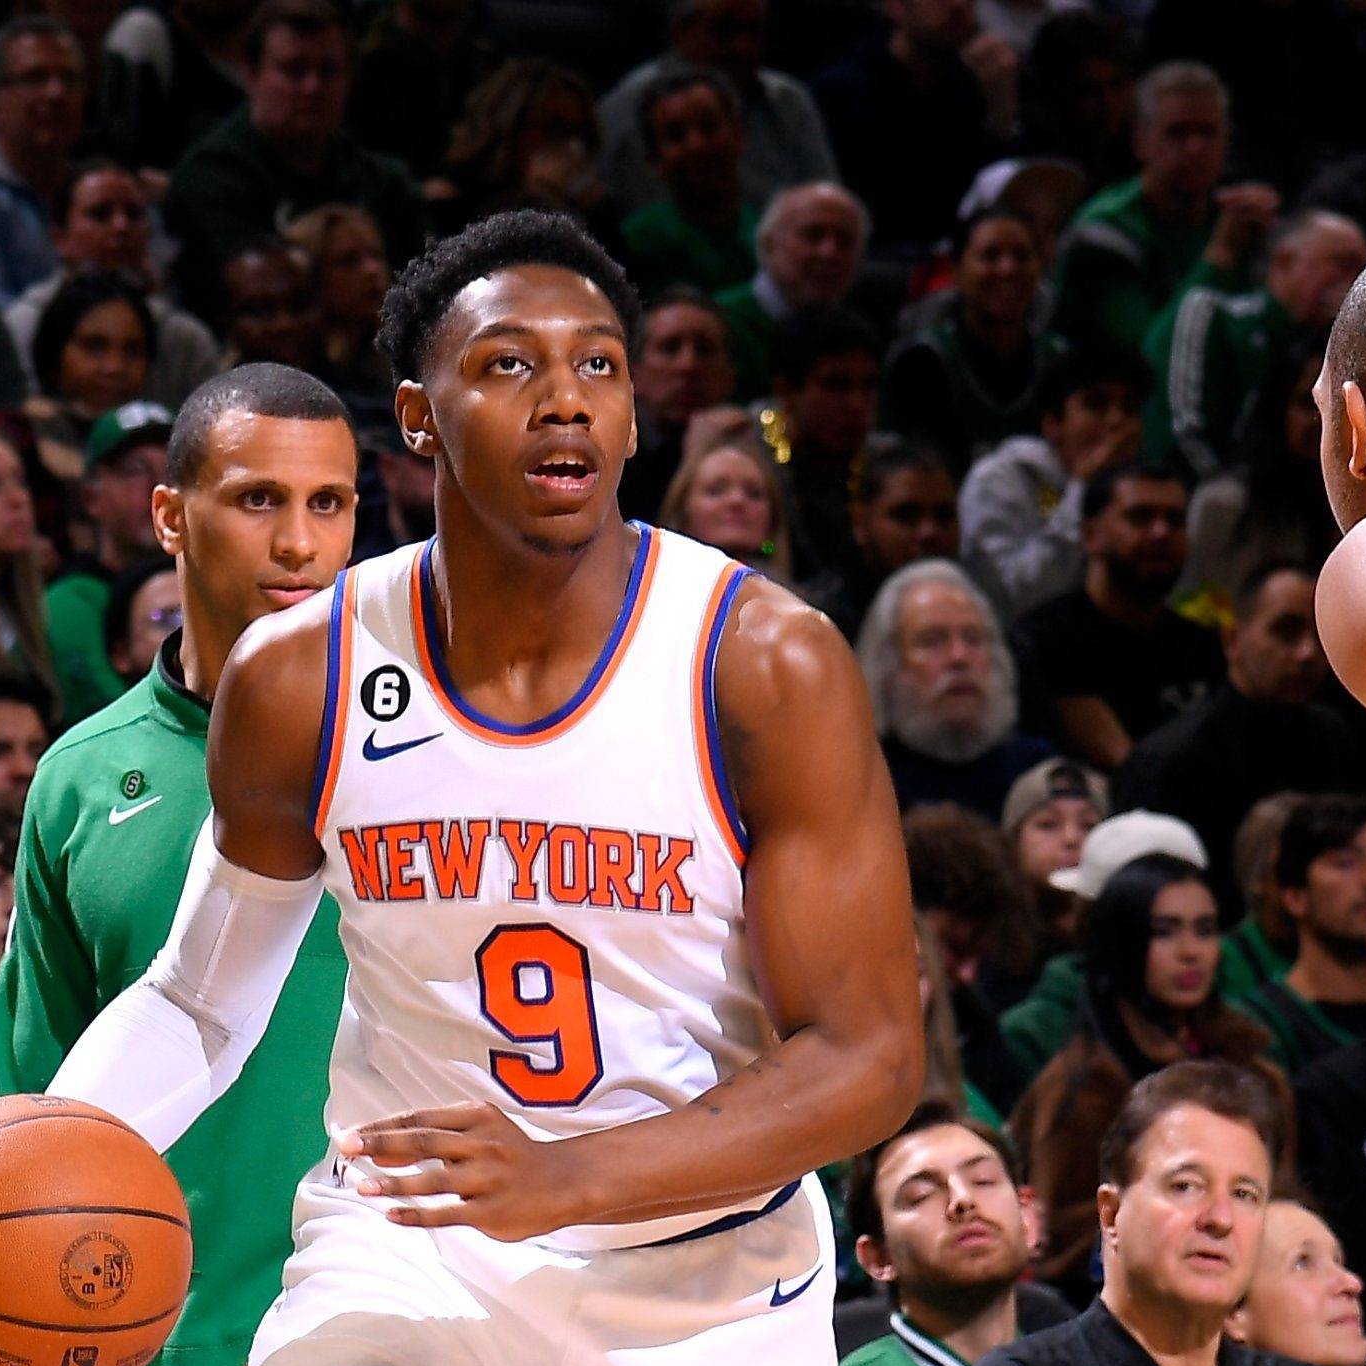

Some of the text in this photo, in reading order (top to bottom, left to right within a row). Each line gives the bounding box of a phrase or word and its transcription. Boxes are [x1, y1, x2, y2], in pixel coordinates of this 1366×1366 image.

[373, 672, 401, 716] 6
[124, 772, 141, 797] 6
[337, 818, 697, 917] NEW YORK
[475, 922, 605, 1108] 9
